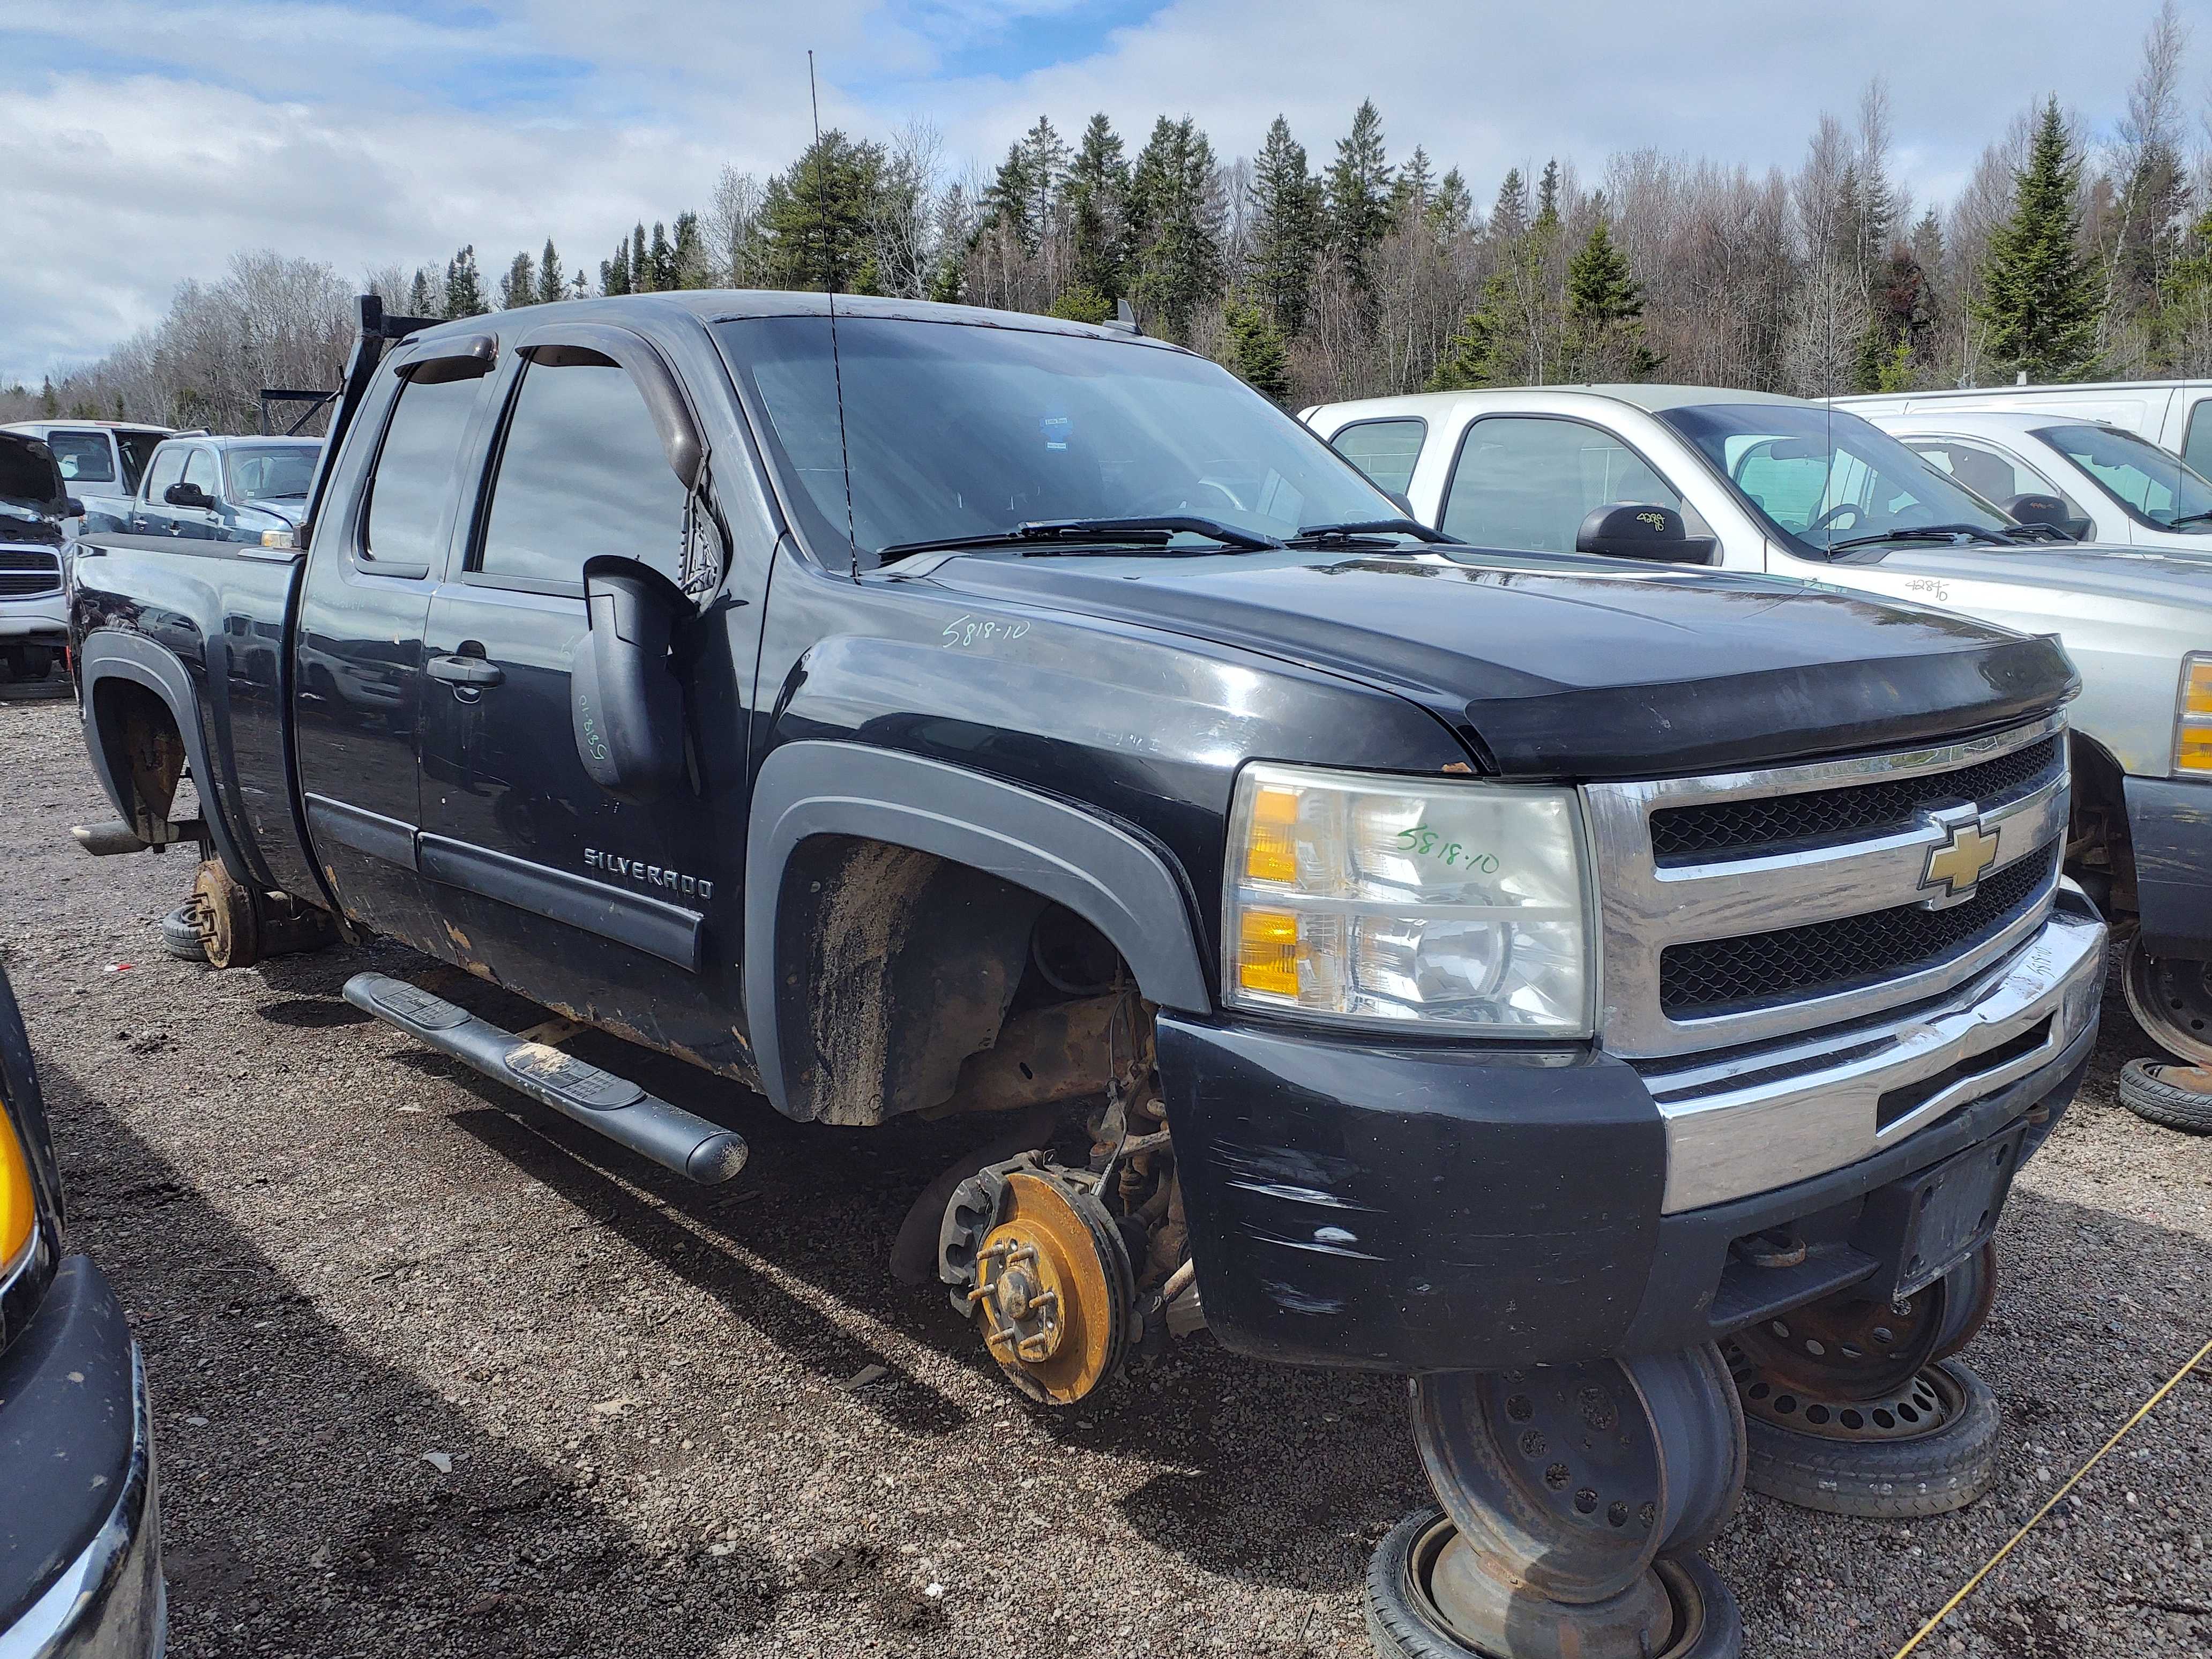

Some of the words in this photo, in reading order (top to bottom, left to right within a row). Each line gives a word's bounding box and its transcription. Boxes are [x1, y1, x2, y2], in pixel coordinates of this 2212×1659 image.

[942, 614, 1030, 648] 5818-10
[579, 694, 608, 760] 5818-10
[584, 848, 714, 900] SILVERADO
